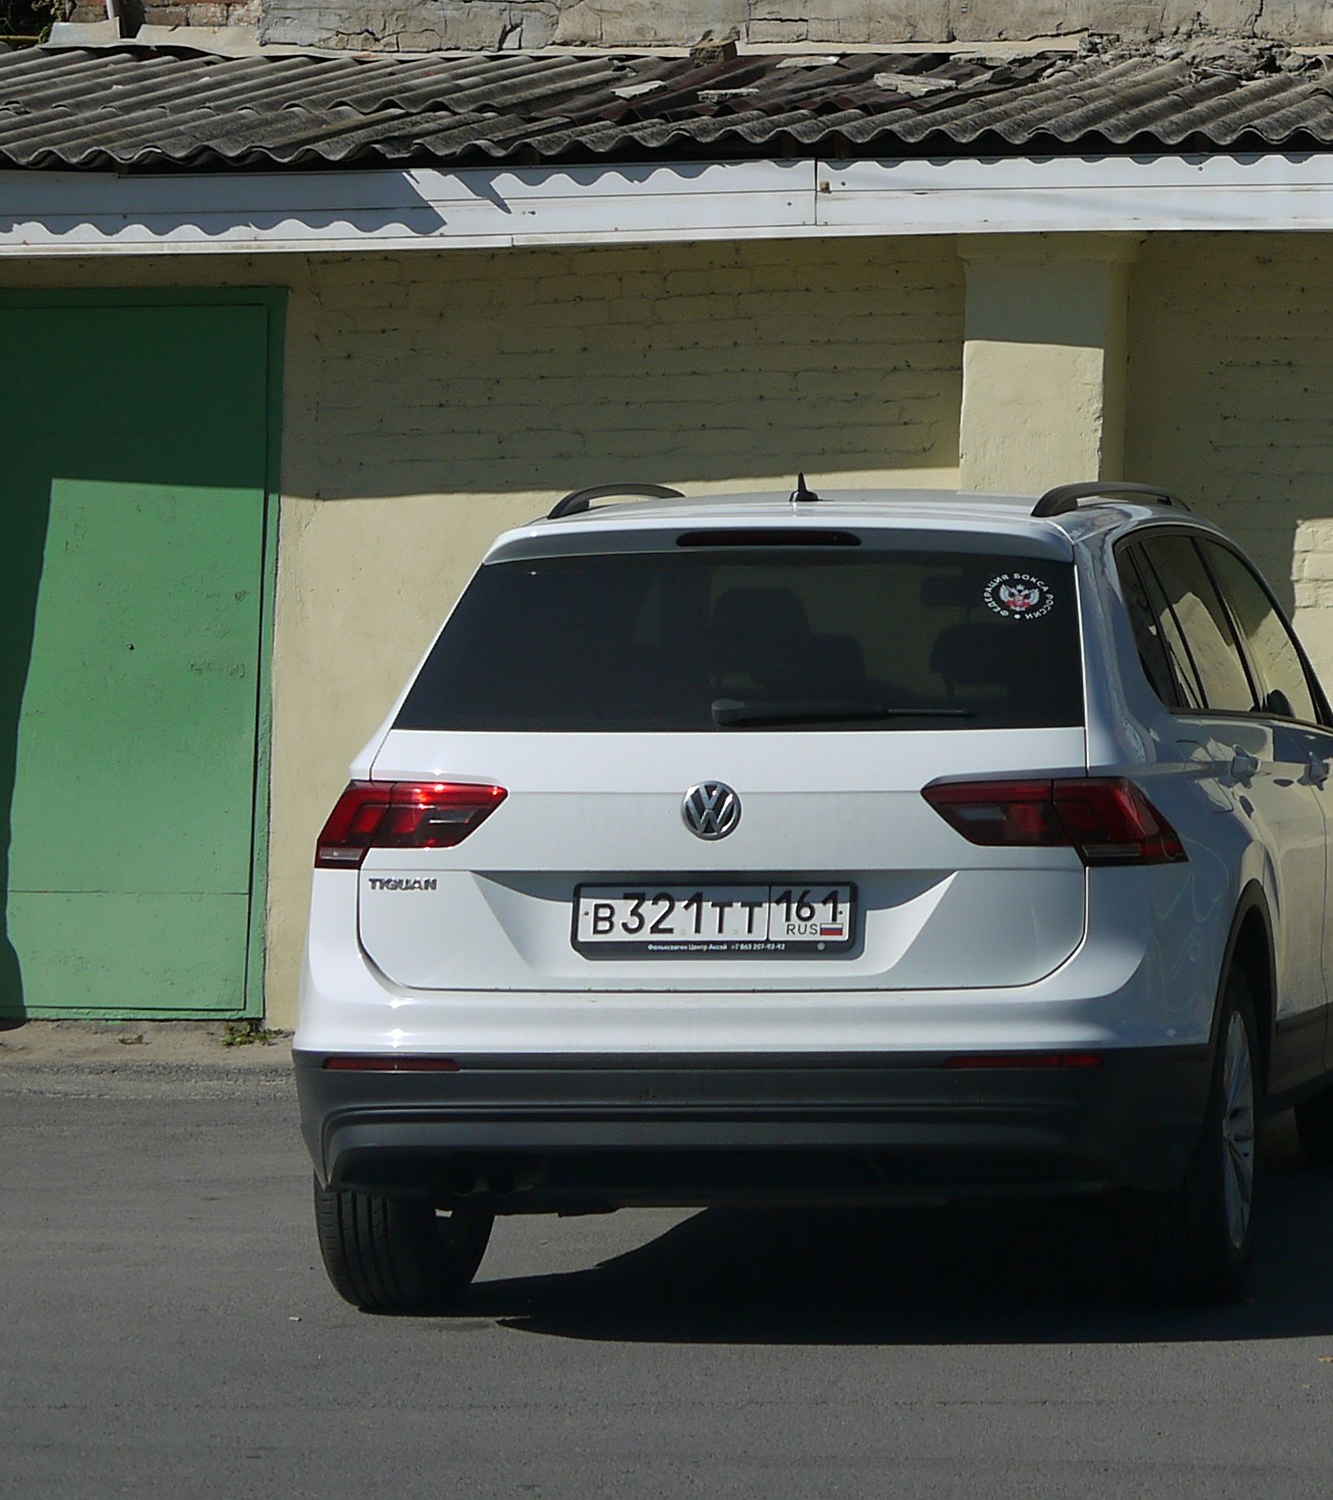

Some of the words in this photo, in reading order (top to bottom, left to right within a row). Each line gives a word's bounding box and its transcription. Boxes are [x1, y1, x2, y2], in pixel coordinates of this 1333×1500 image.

[983, 573, 1010, 617] ФЕДЕРАЦИЯ
[1013, 573, 1050, 593] БОКСА
[1024, 593, 1055, 621] РОССИИ
[368, 877, 438, 891] TIGUAN
[774, 889, 840, 923] 161
[786, 923, 818, 936] RUS
